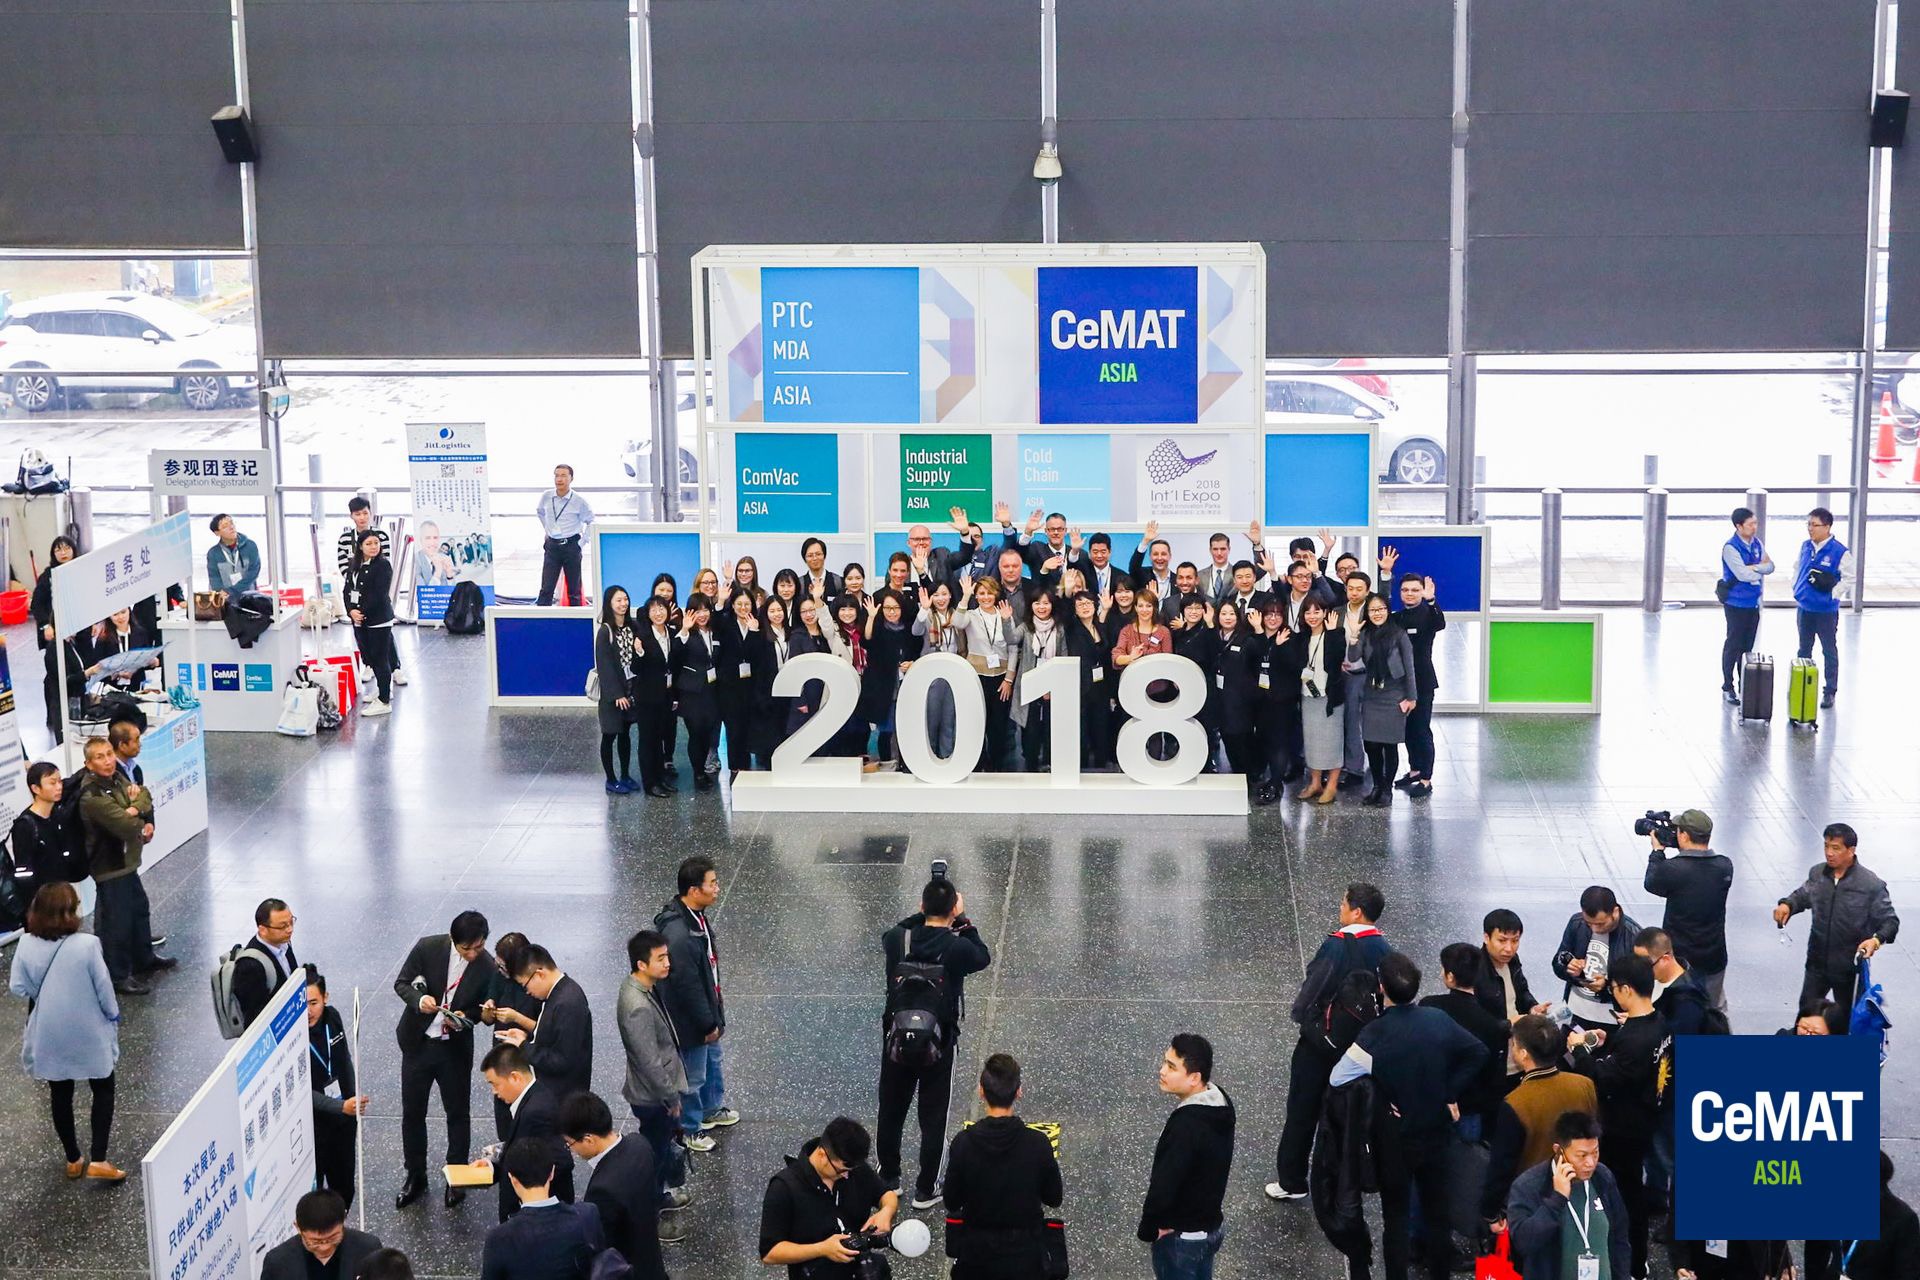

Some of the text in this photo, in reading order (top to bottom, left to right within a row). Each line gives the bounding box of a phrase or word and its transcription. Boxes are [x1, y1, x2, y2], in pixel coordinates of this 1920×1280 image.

[772, 301, 814, 328] PTC
[1051, 309, 1186, 350] CeMAT
[773, 340, 810, 360] MDA
[1099, 362, 1138, 383] ASIA
[772, 385, 812, 405] ASIA
[905, 448, 968, 465] Industrial
[1024, 447, 1053, 464] Cold
[163, 458, 259, 477] 参观团登记
[742, 467, 800, 486] ComVac
[906, 466, 951, 487] Supply
[1024, 466, 1059, 483] Chain
[165, 477, 259, 488] Delegation Registration
[1196, 479, 1221, 489] 2018
[906, 496, 930, 509] ASIA
[1025, 496, 1045, 508] ASIA
[1183, 489, 1221, 503] Expo
[742, 501, 769, 515] ASIA
[105, 545, 151, 583] 服务处
[105, 569, 151, 597] Services Counter
[213, 670, 238, 679] CeMAT
[771, 652, 1209, 786] 2018
[183, 1140, 217, 1195] 本次展览
[169, 1152, 235, 1256] 只供业内人士参观
